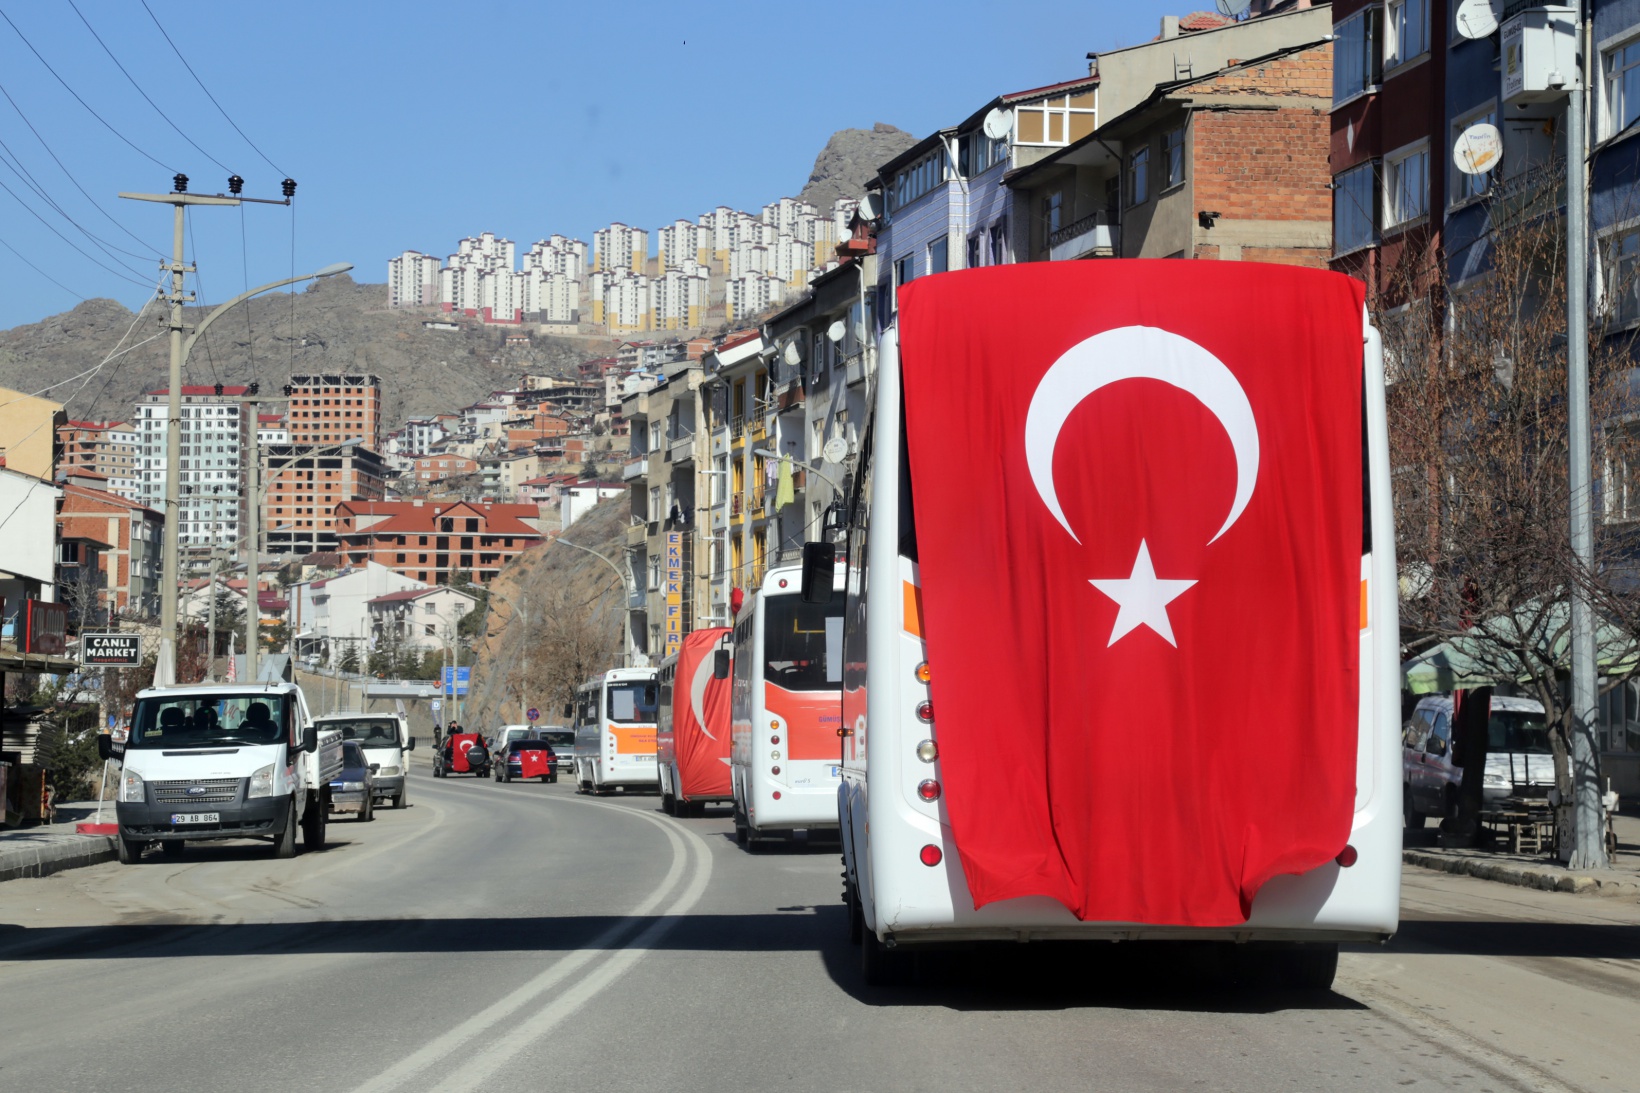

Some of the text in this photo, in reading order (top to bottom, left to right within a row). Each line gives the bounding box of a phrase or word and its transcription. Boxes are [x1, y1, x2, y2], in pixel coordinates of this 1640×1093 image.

[669, 534, 680, 592] EKMEK
[93, 638, 130, 647] CANLI
[86, 648, 137, 657] MARKET
